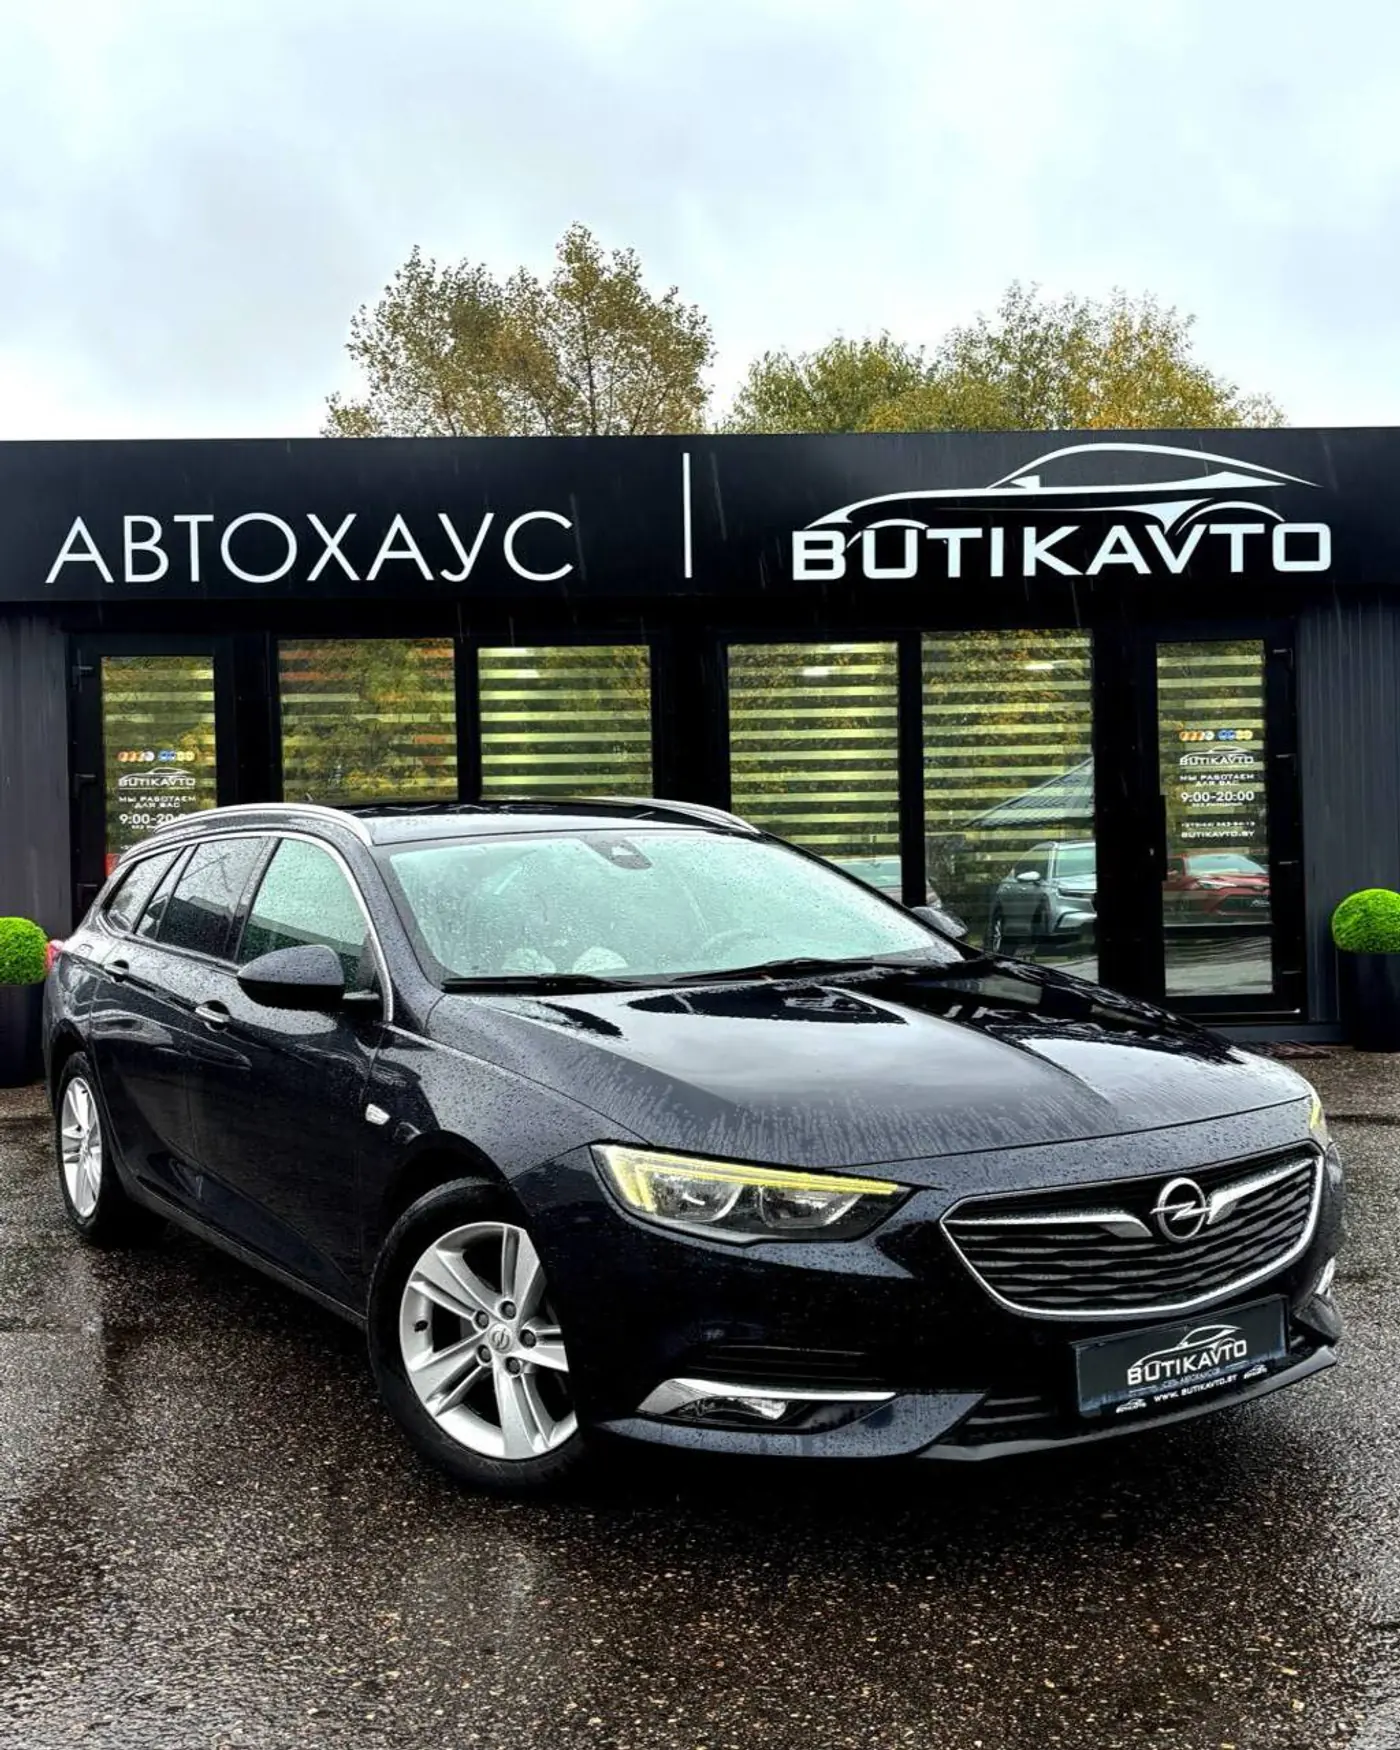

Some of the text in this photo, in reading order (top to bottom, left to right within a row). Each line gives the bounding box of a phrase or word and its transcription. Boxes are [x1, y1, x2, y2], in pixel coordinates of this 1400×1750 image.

[45, 511, 574, 584] АВТОХАУС
[792, 520, 1332, 581] BUTIKAVTO
[1180, 756, 1254, 765] BUTIKAVTO
[119, 777, 196, 787] BUTIKAVTO
[1181, 791, 1255, 802] 9:00-20:00
[1127, 1340, 1248, 1386] BUTIKAVTO
